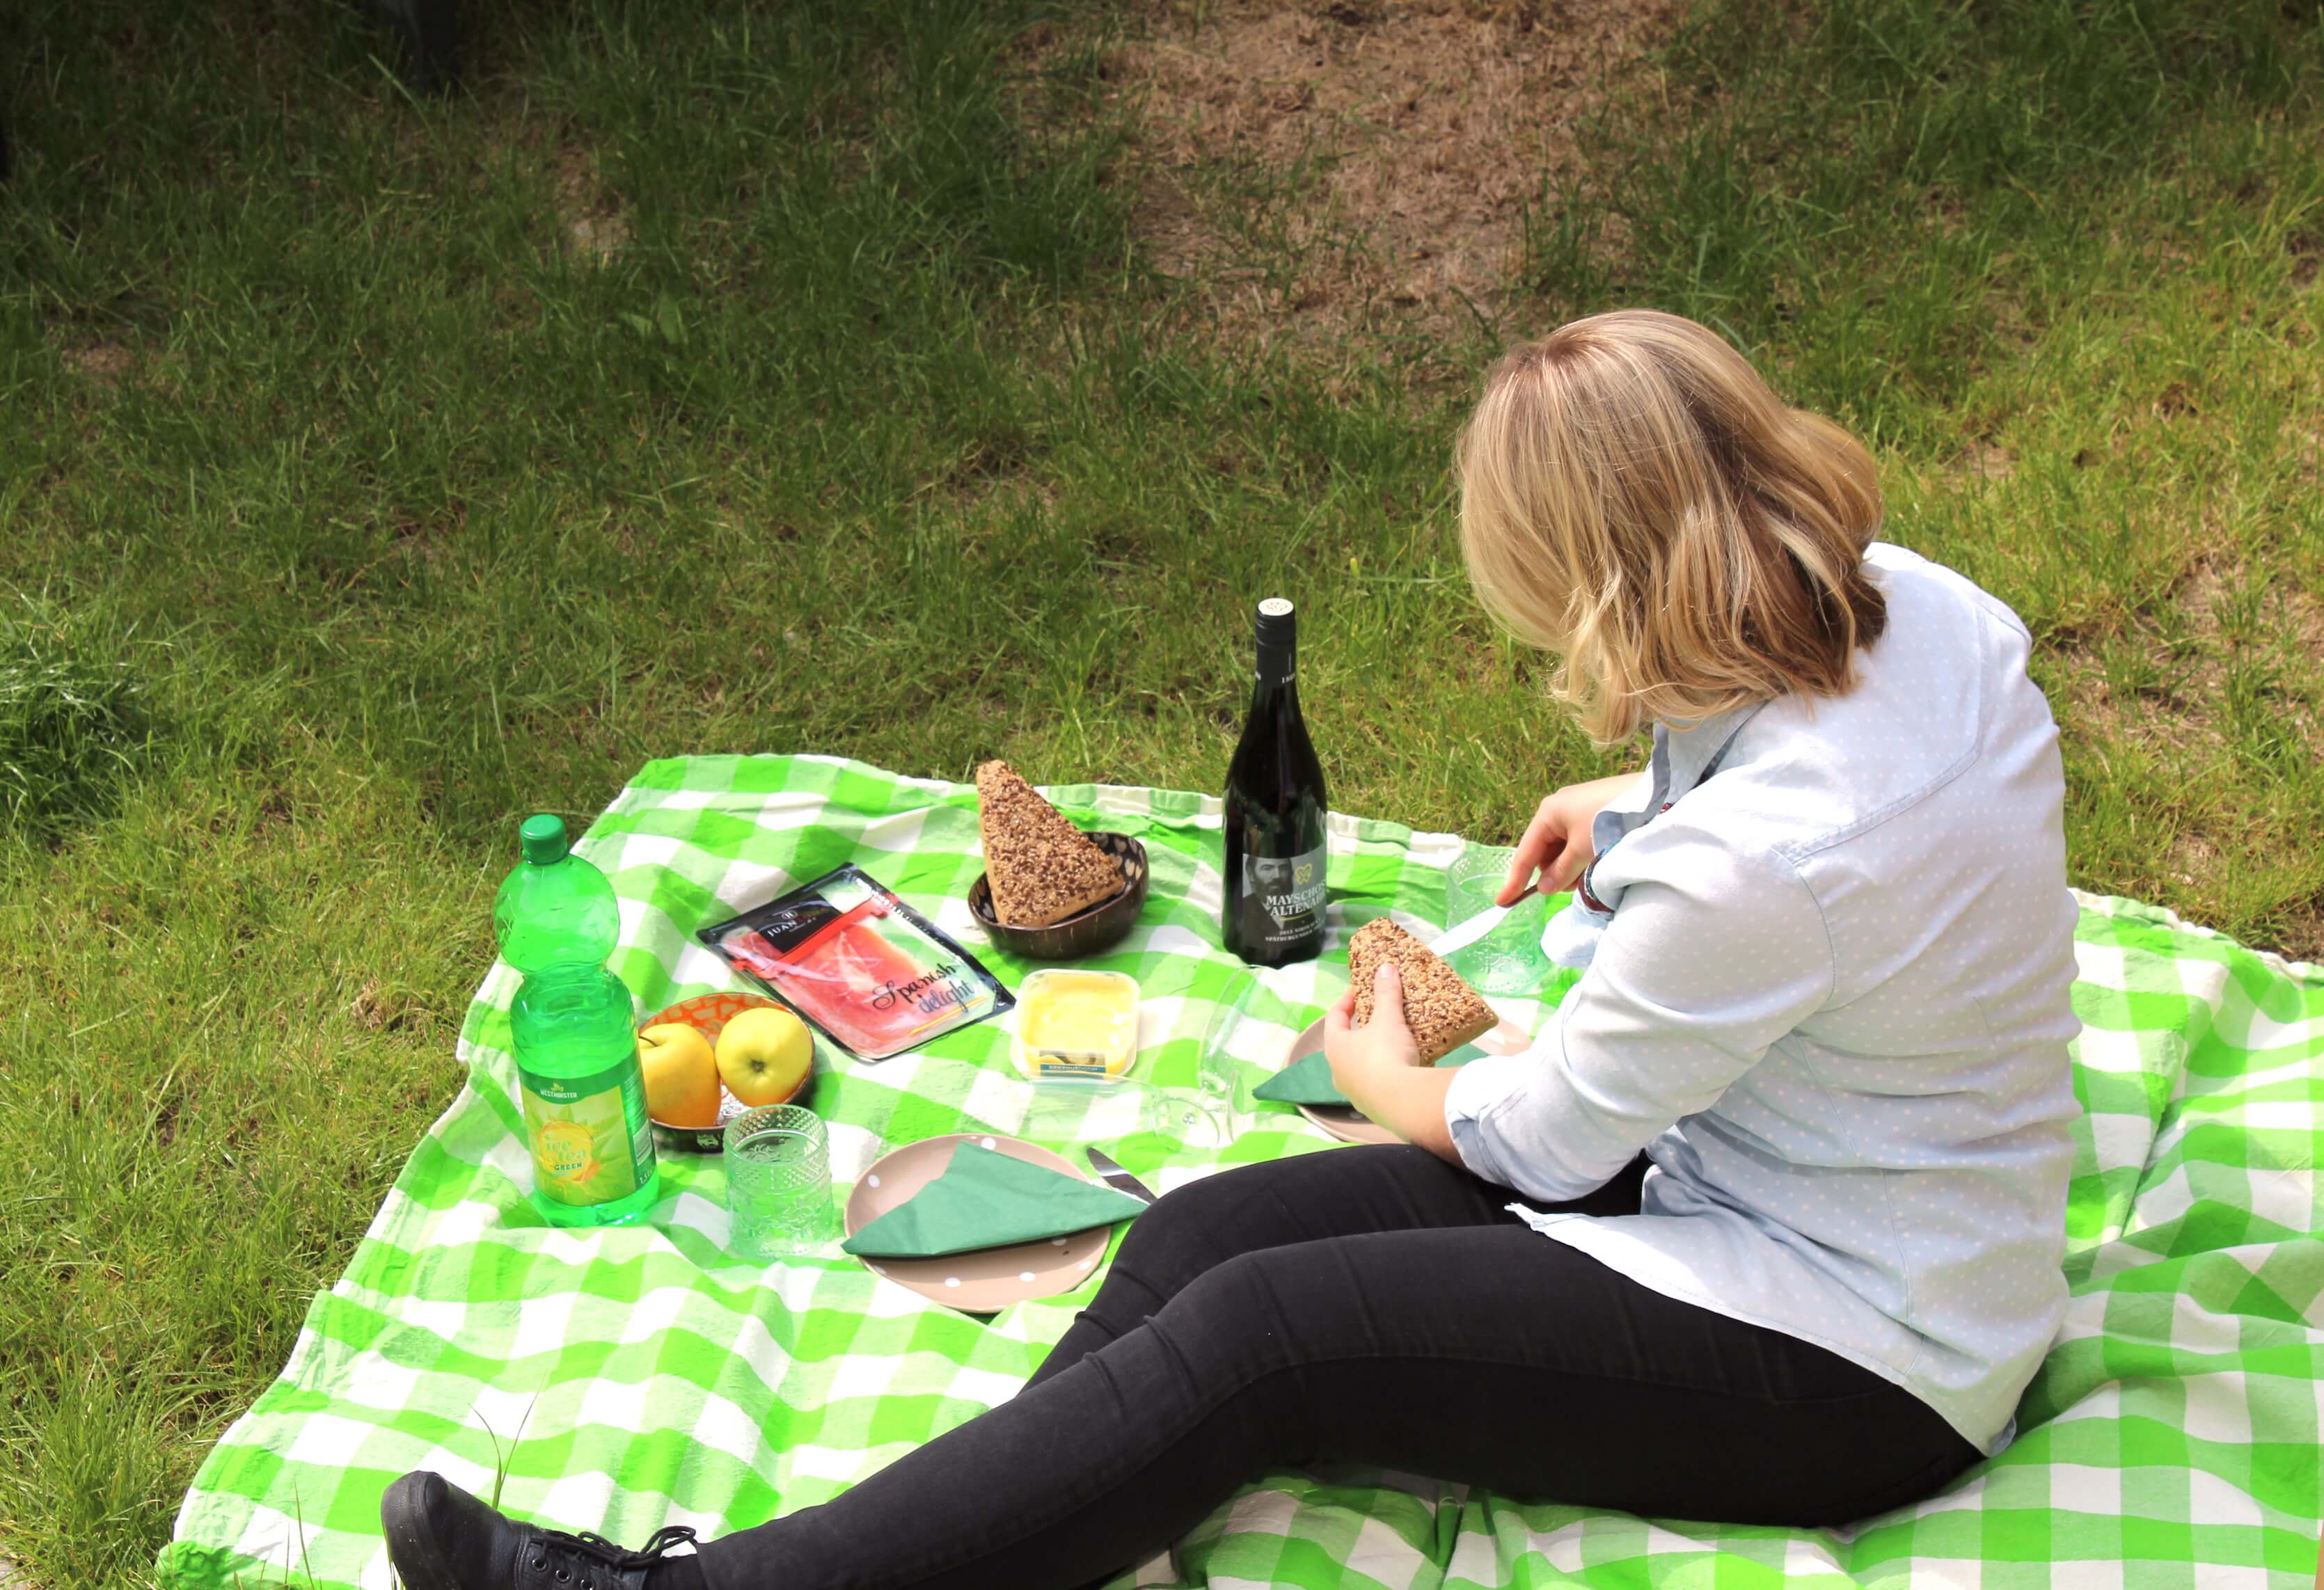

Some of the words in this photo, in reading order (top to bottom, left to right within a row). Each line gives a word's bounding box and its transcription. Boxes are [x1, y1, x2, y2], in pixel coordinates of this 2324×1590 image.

[767, 919, 798, 937] JUAN
[872, 963, 957, 1010] Spanish
[918, 980, 975, 1014] delight
[545, 1132, 571, 1152] ice
[557, 1147, 587, 1163] tea
[554, 1161, 583, 1171] GREEN
